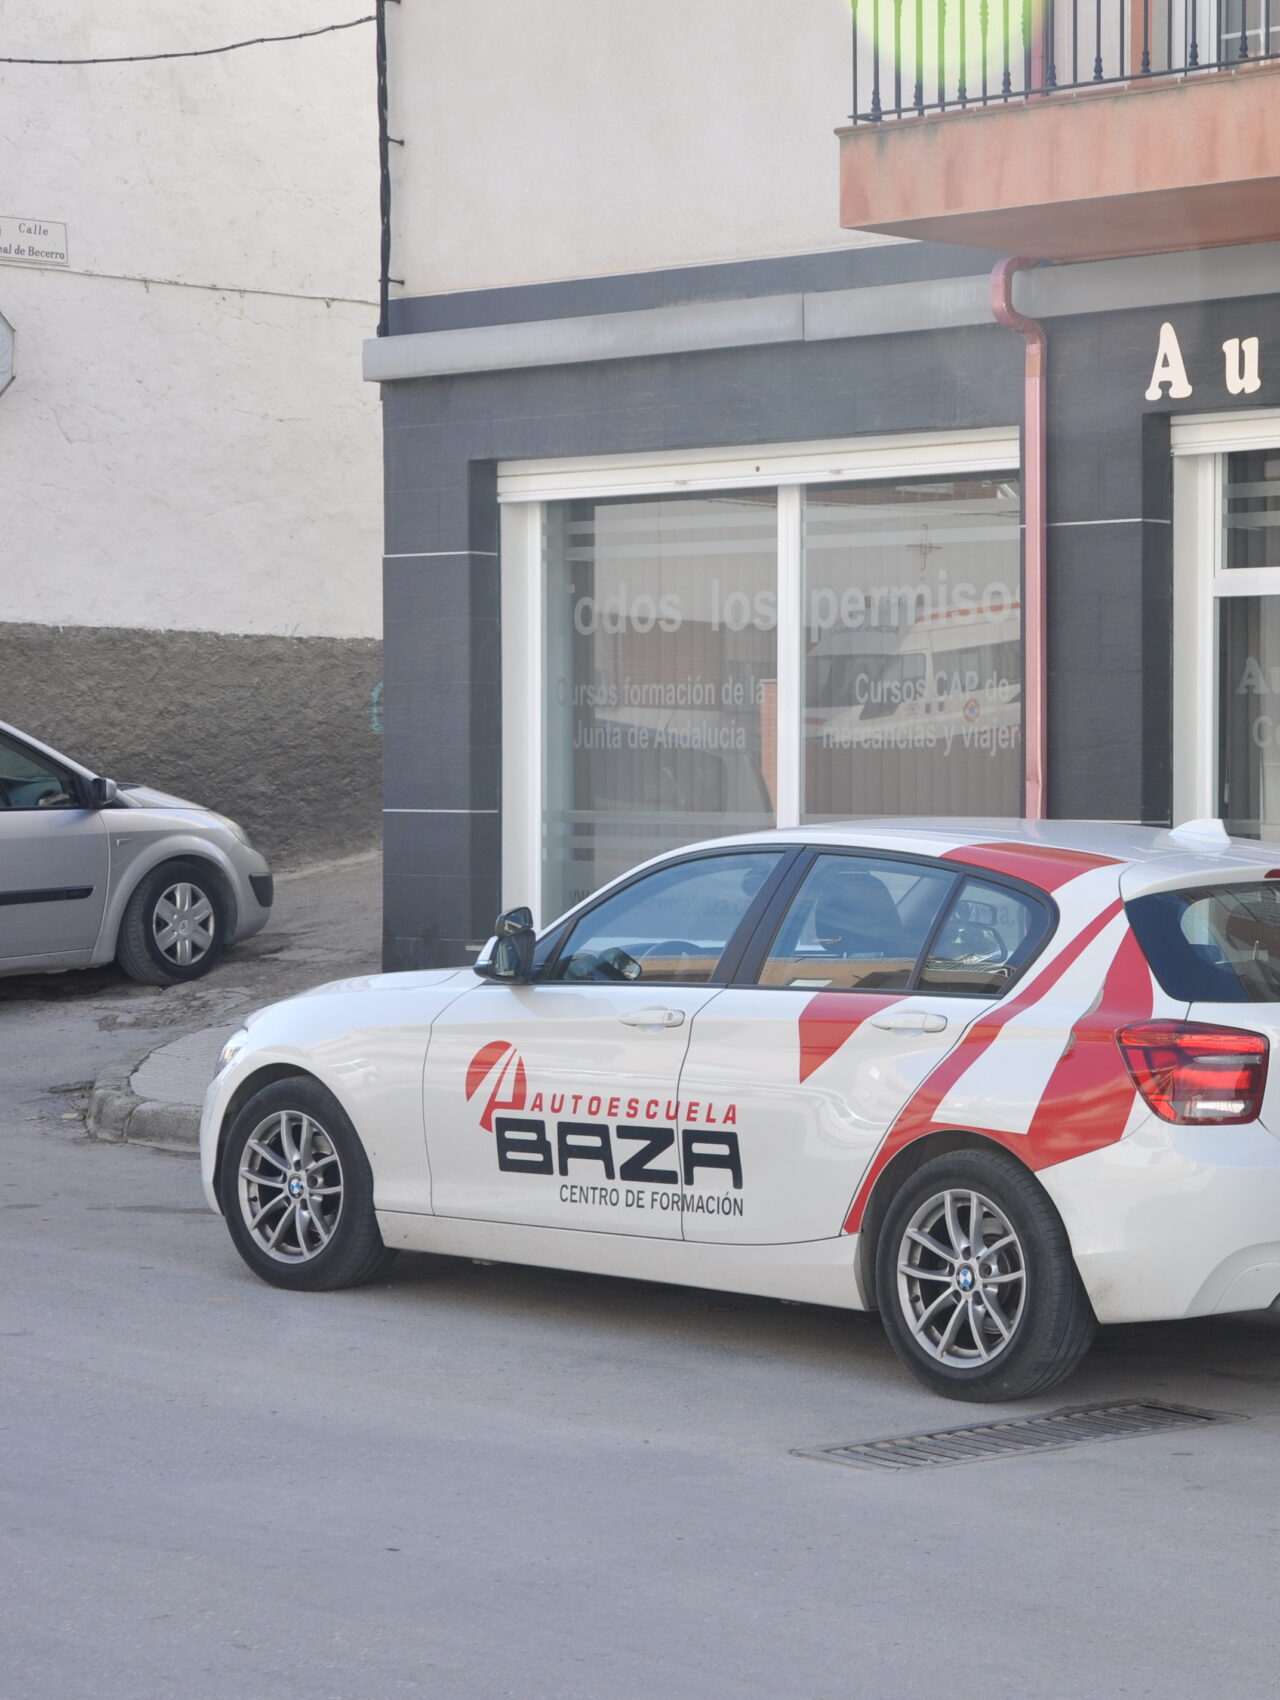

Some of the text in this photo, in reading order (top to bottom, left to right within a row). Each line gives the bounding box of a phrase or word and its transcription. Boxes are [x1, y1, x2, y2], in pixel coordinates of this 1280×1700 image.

[18, 222, 49, 236] Calle
[14, 244, 26, 255] de
[28, 245, 65, 260] Becerro
[810, 569, 1021, 643] permiso
[623, 675, 716, 705] formación
[721, 675, 744, 704] de
[855, 669, 1010, 704] Cursos CAP de
[572, 718, 747, 749] Junta de Andalucía
[943, 722, 956, 756] y
[961, 717, 1021, 757] viajer
[530, 1092, 738, 1125] AUTOESCUELA
[495, 1116, 744, 1190] BAZA
[559, 1183, 744, 1217] CENTRO DE FORMACIÓN
